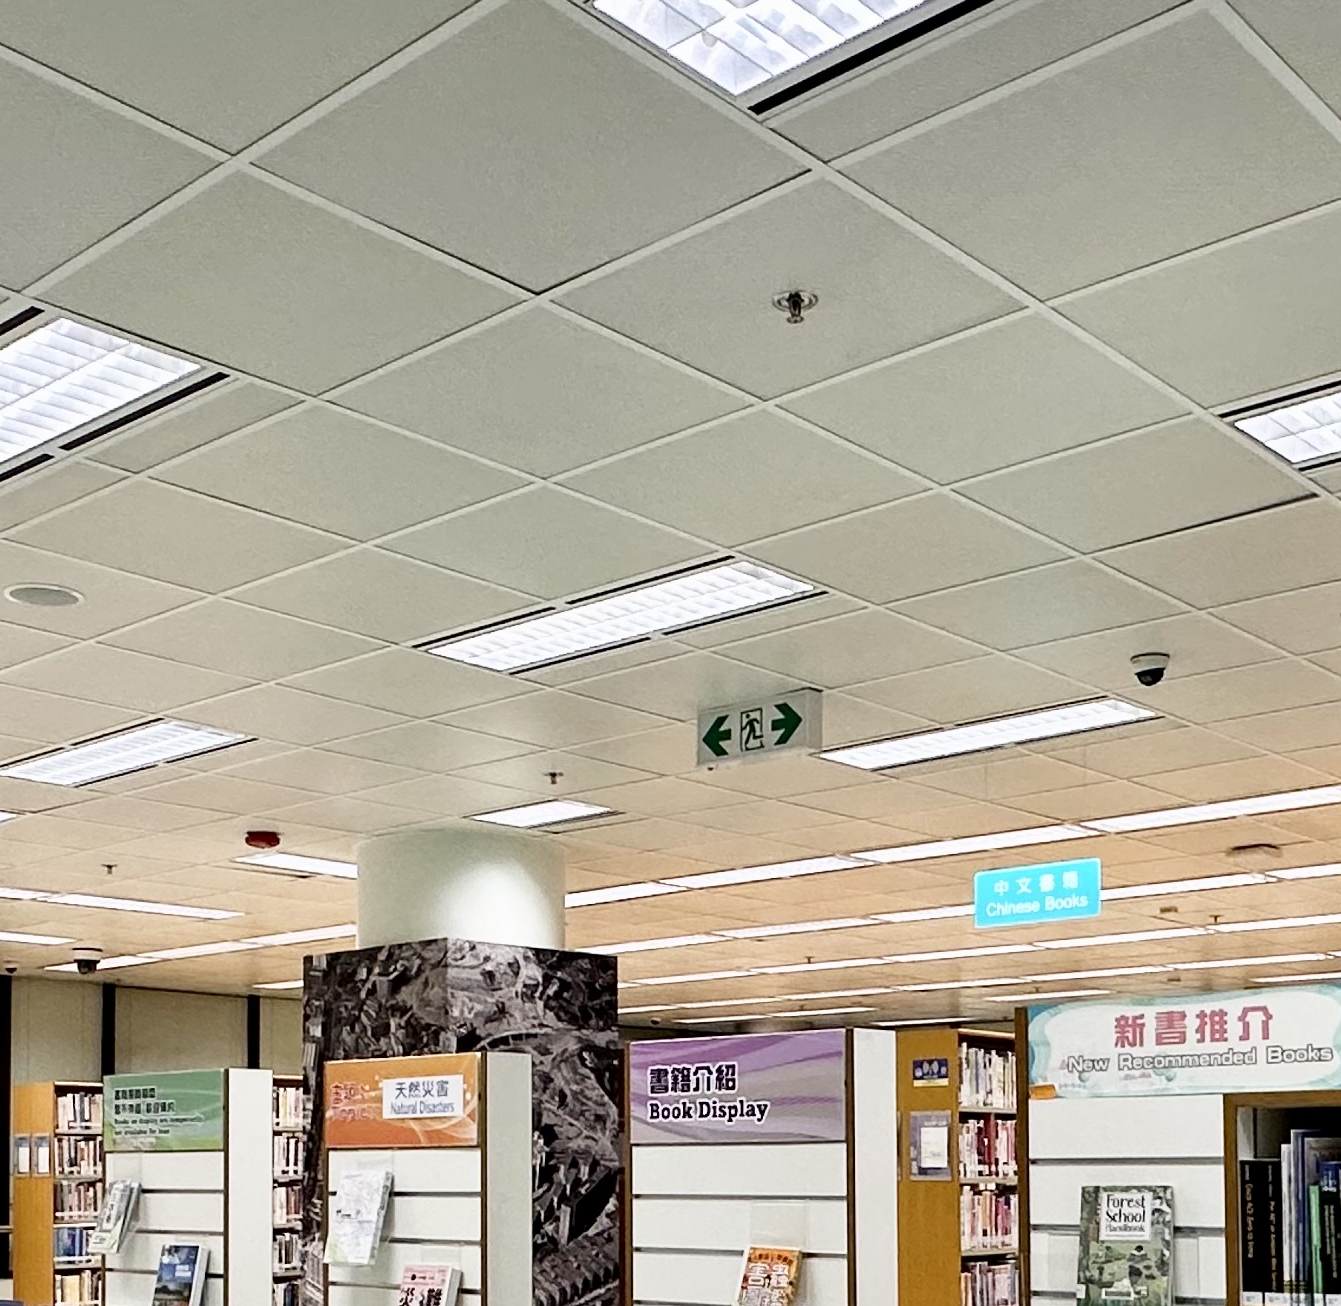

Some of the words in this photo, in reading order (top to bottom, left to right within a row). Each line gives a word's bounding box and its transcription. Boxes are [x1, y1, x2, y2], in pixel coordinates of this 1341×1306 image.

[985, 900, 1040, 917] Chinese
[1044, 893, 1089, 912] Books
[1114, 1005, 1274, 1049] 新書推介
[1066, 1054, 1110, 1073] New
[1117, 1046, 1258, 1071] Recommended
[1266, 1043, 1334, 1064] Books
[395, 1079, 449, 1100] 天然災害
[649, 1063, 737, 1095] 書籍介紹
[390, 1101, 418, 1115] Natural
[419, 1100, 455, 1115] Disasters
[649, 1101, 693, 1120] Book
[698, 1099, 769, 1123] Display
[1106, 1193, 1146, 1209] Forest
[1105, 1208, 1146, 1223] School
